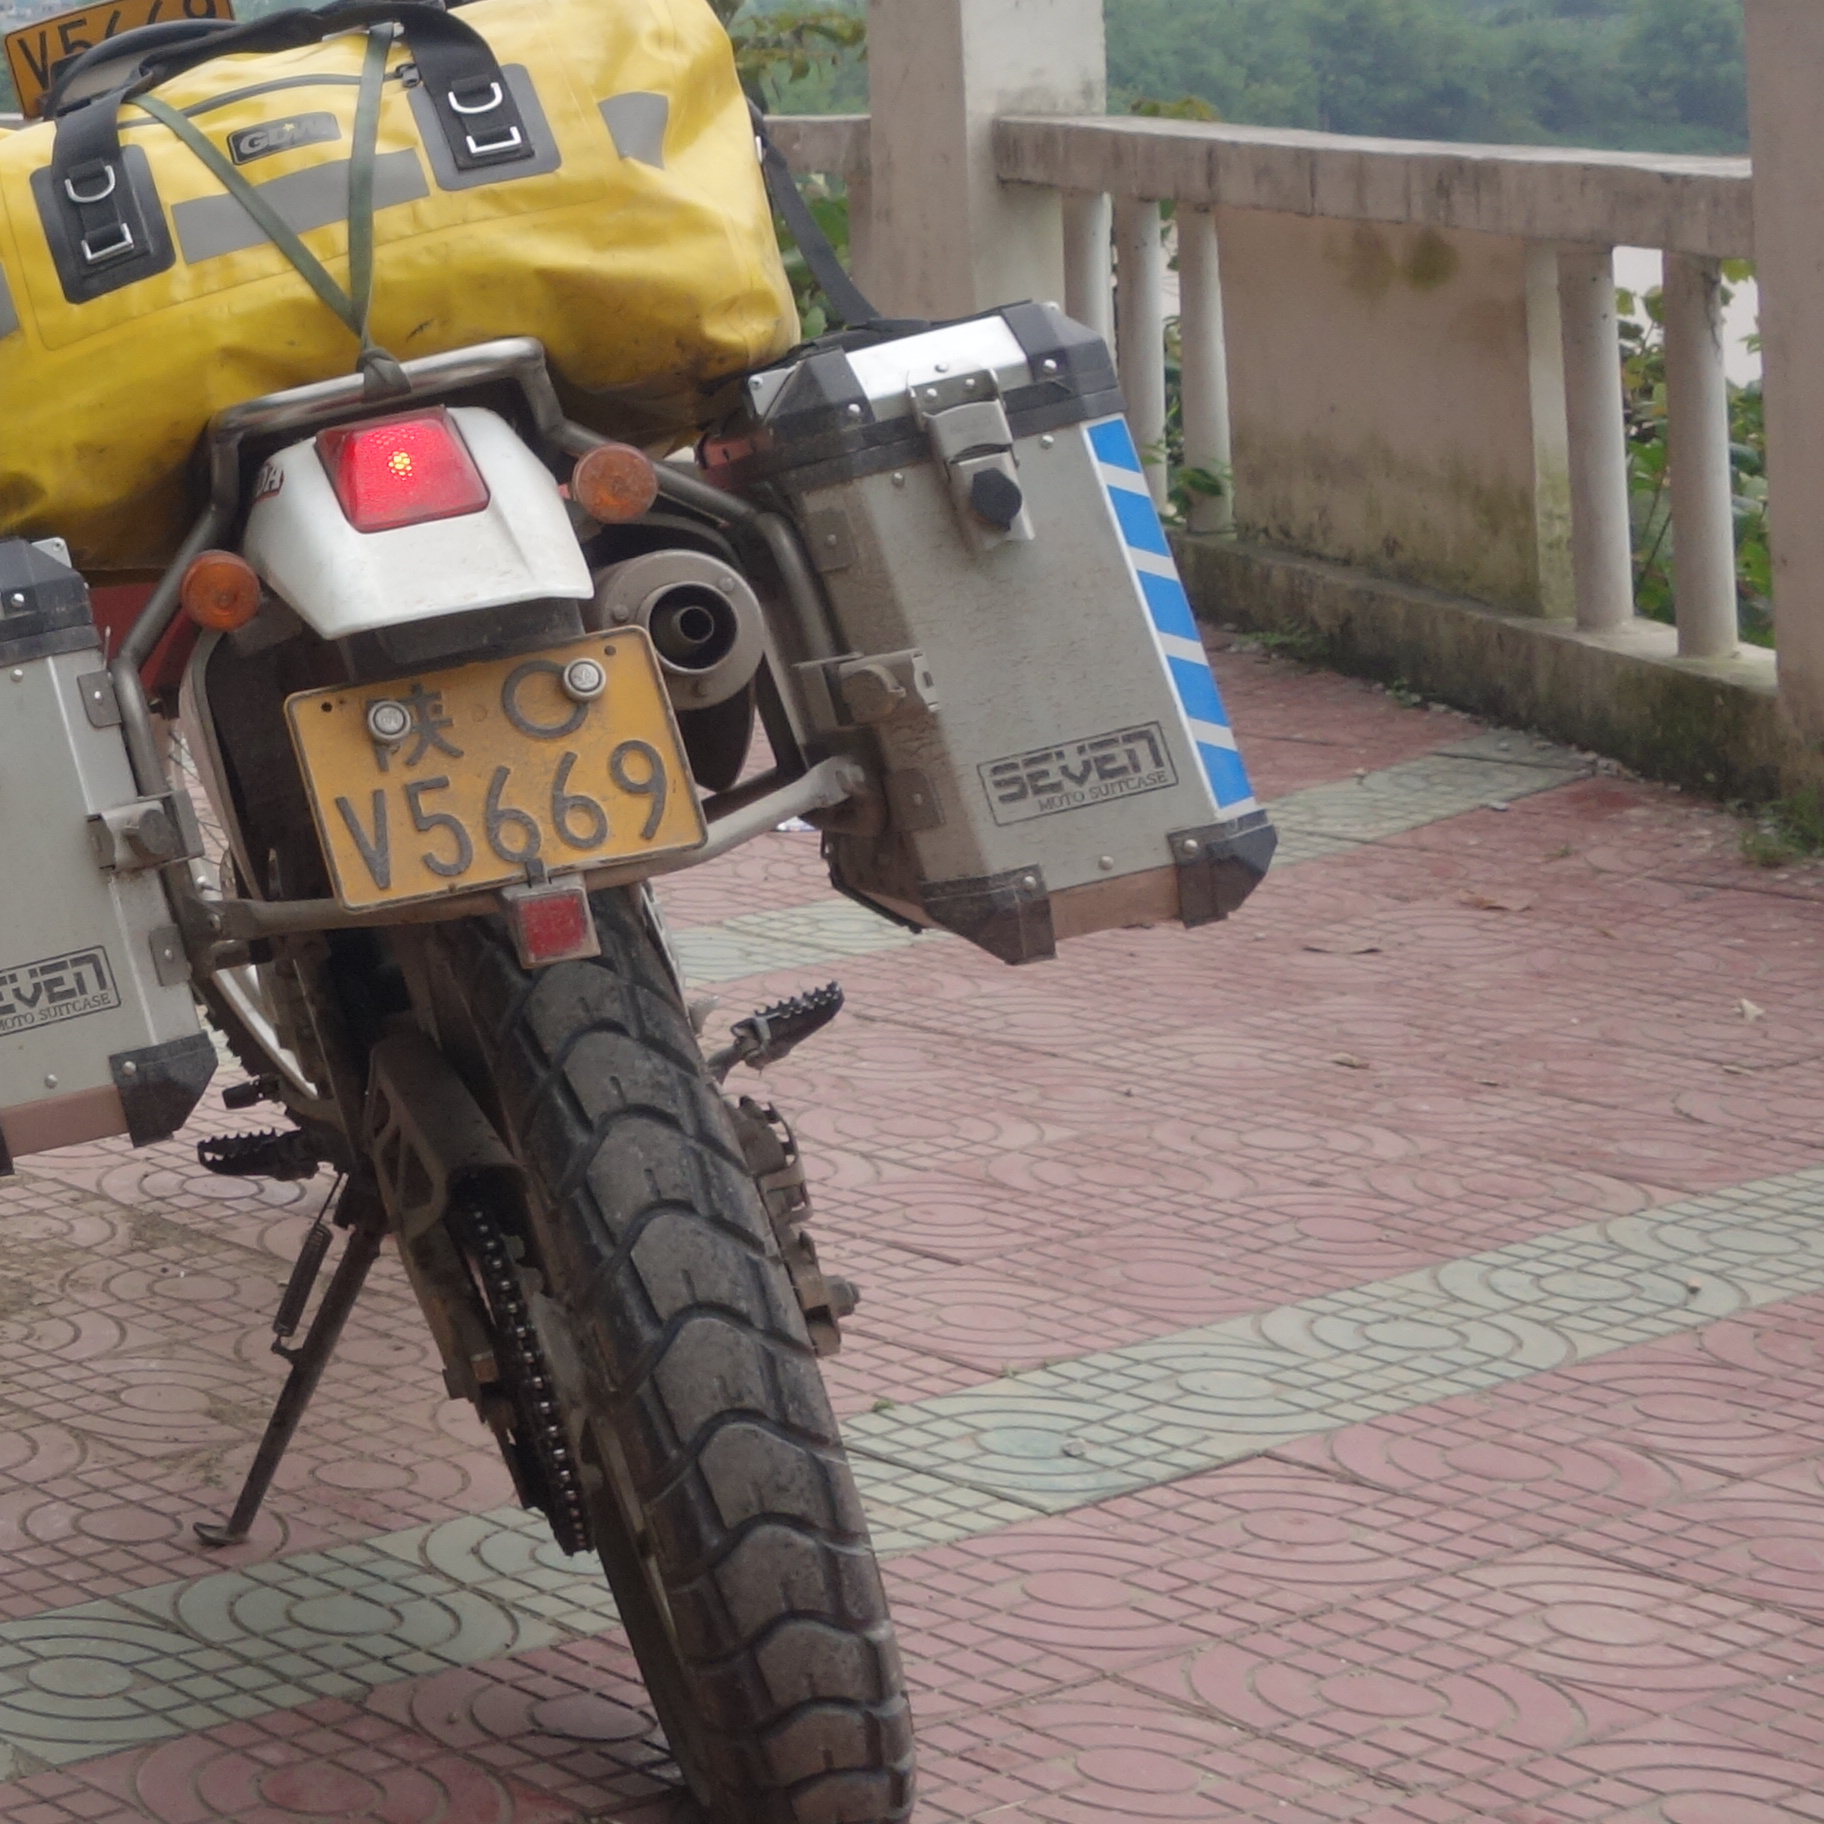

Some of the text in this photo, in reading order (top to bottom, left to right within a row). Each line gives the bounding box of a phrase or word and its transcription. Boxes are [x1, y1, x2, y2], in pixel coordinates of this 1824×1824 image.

[990, 729, 1164, 804] SEVEN
[1038, 771, 1168, 812] MOTO SUITCASE
[336, 739, 667, 889] V5669
[40, 992, 112, 1021] SUITCASE
